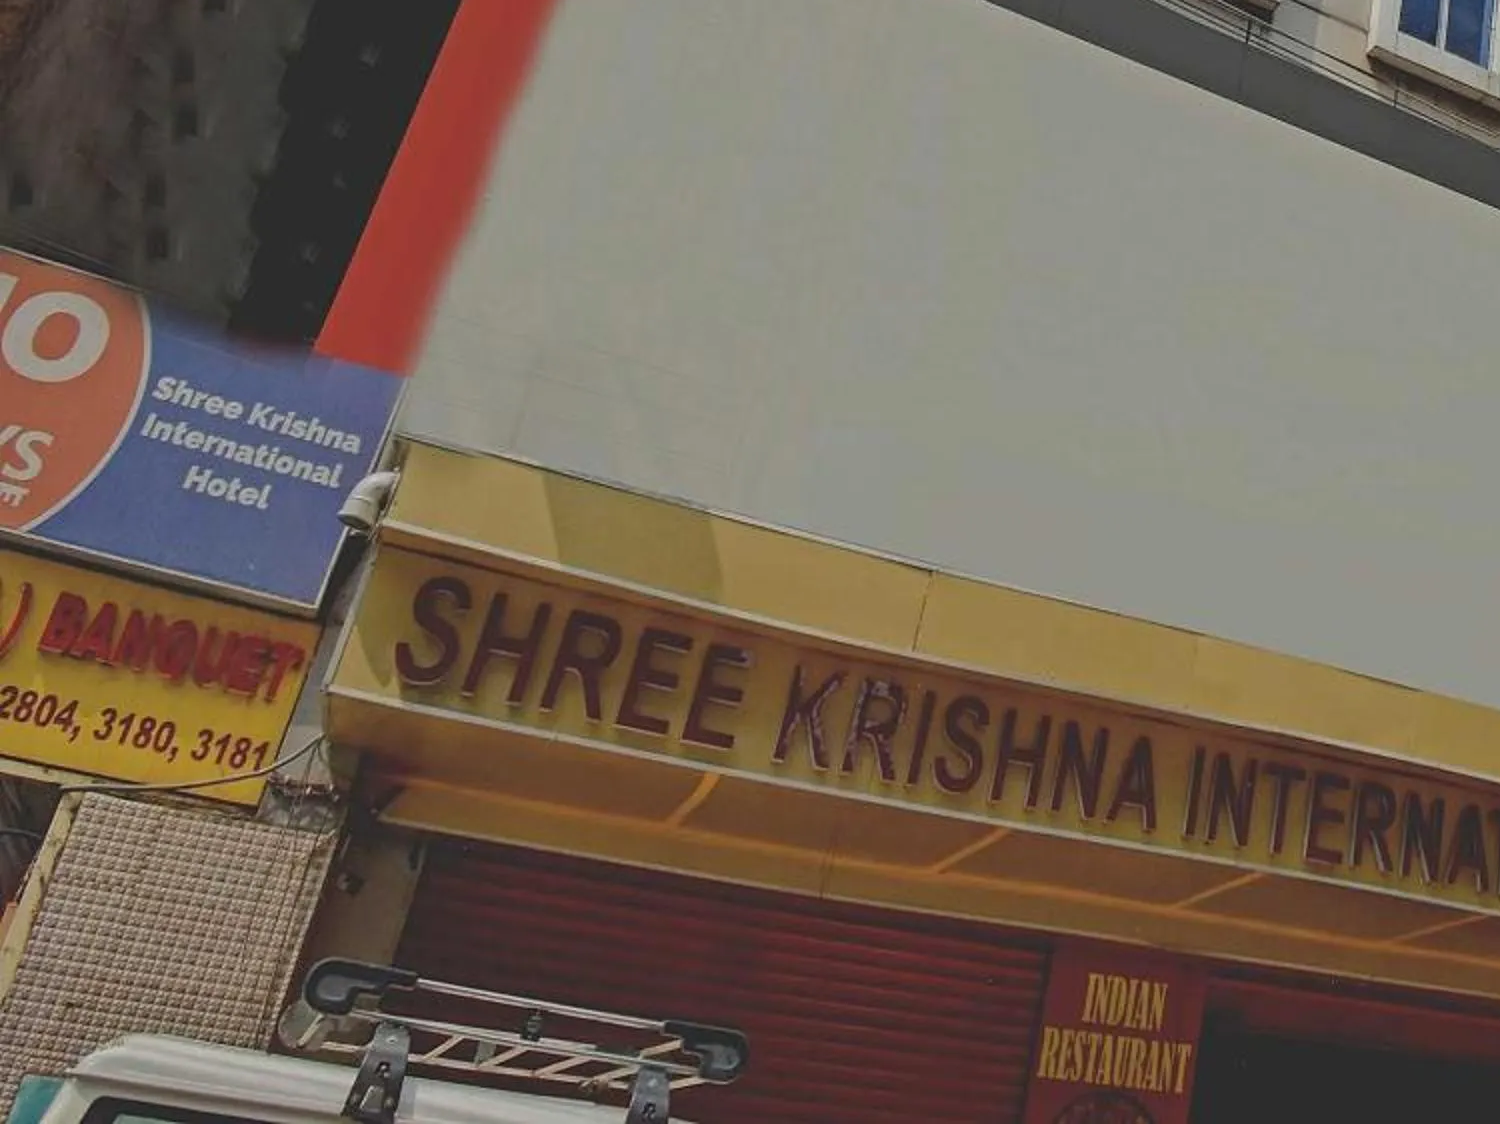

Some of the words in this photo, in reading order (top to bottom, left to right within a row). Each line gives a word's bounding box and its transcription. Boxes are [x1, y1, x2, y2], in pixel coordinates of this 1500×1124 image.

[0, 272, 110, 382] O
[141, 413, 344, 488] International
[152, 376, 244, 420] Shree
[247, 402, 361, 455] Krishna
[182, 465, 273, 510] Hotel
[38, 590, 306, 704] BANQUET
[0, 685, 81, 743] 2804,
[93, 707, 179, 763] 3180,
[190, 729, 270, 770] 3181
[394, 575, 752, 750] SHREE
[770, 663, 1158, 834] KRISHNA
[1081, 972, 1169, 1033] INDIAN
[1036, 1026, 1193, 1094] RESTAURANT
